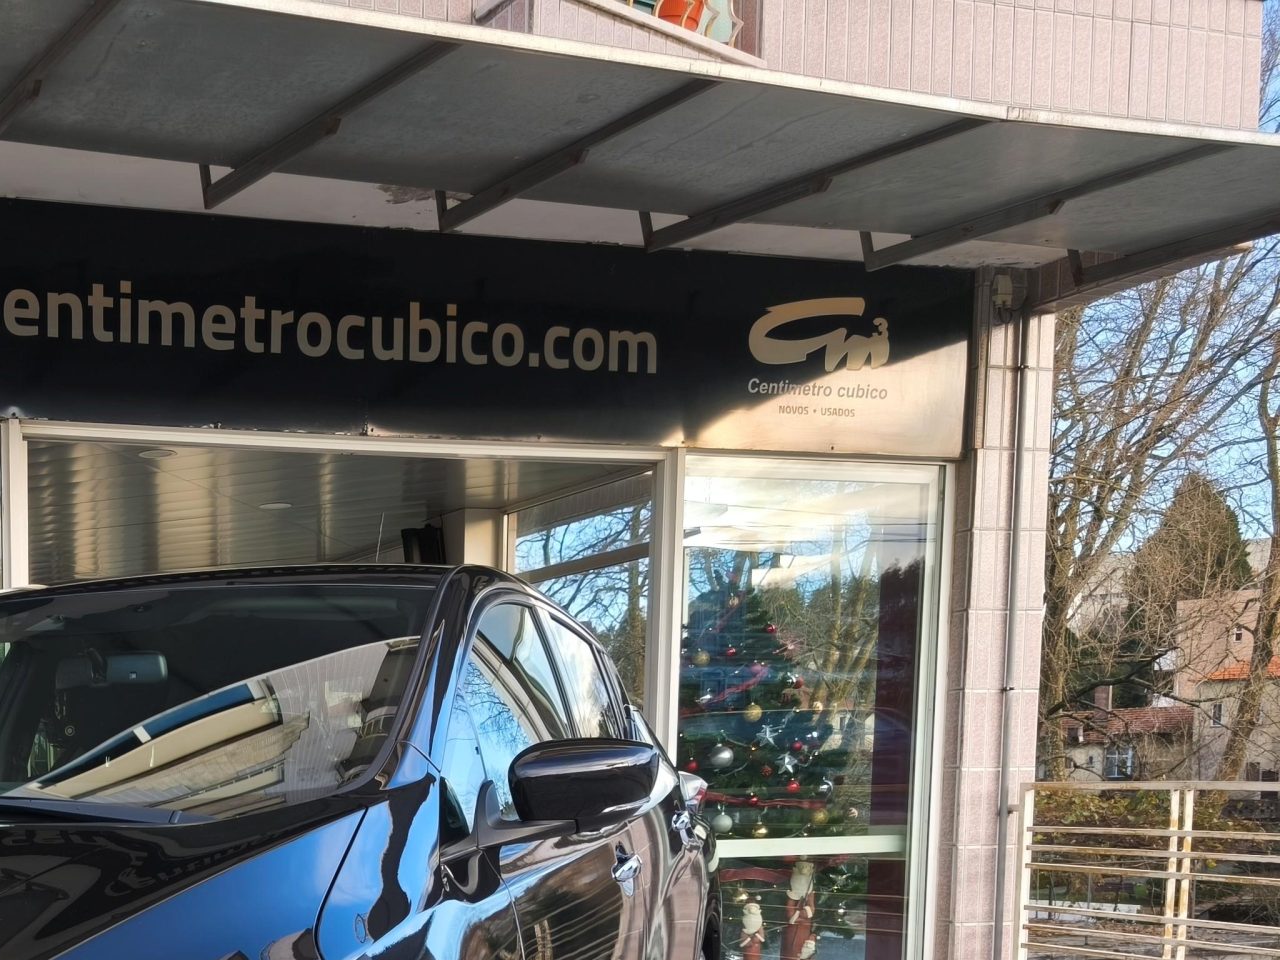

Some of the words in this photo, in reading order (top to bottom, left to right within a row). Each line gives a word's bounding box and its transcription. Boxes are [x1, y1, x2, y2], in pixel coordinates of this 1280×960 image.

[748, 377, 832, 398] Centimetro
[837, 384, 888, 400] cubico
[778, 405, 809, 416] NOVOS
[820, 407, 856, 418] USADOS
